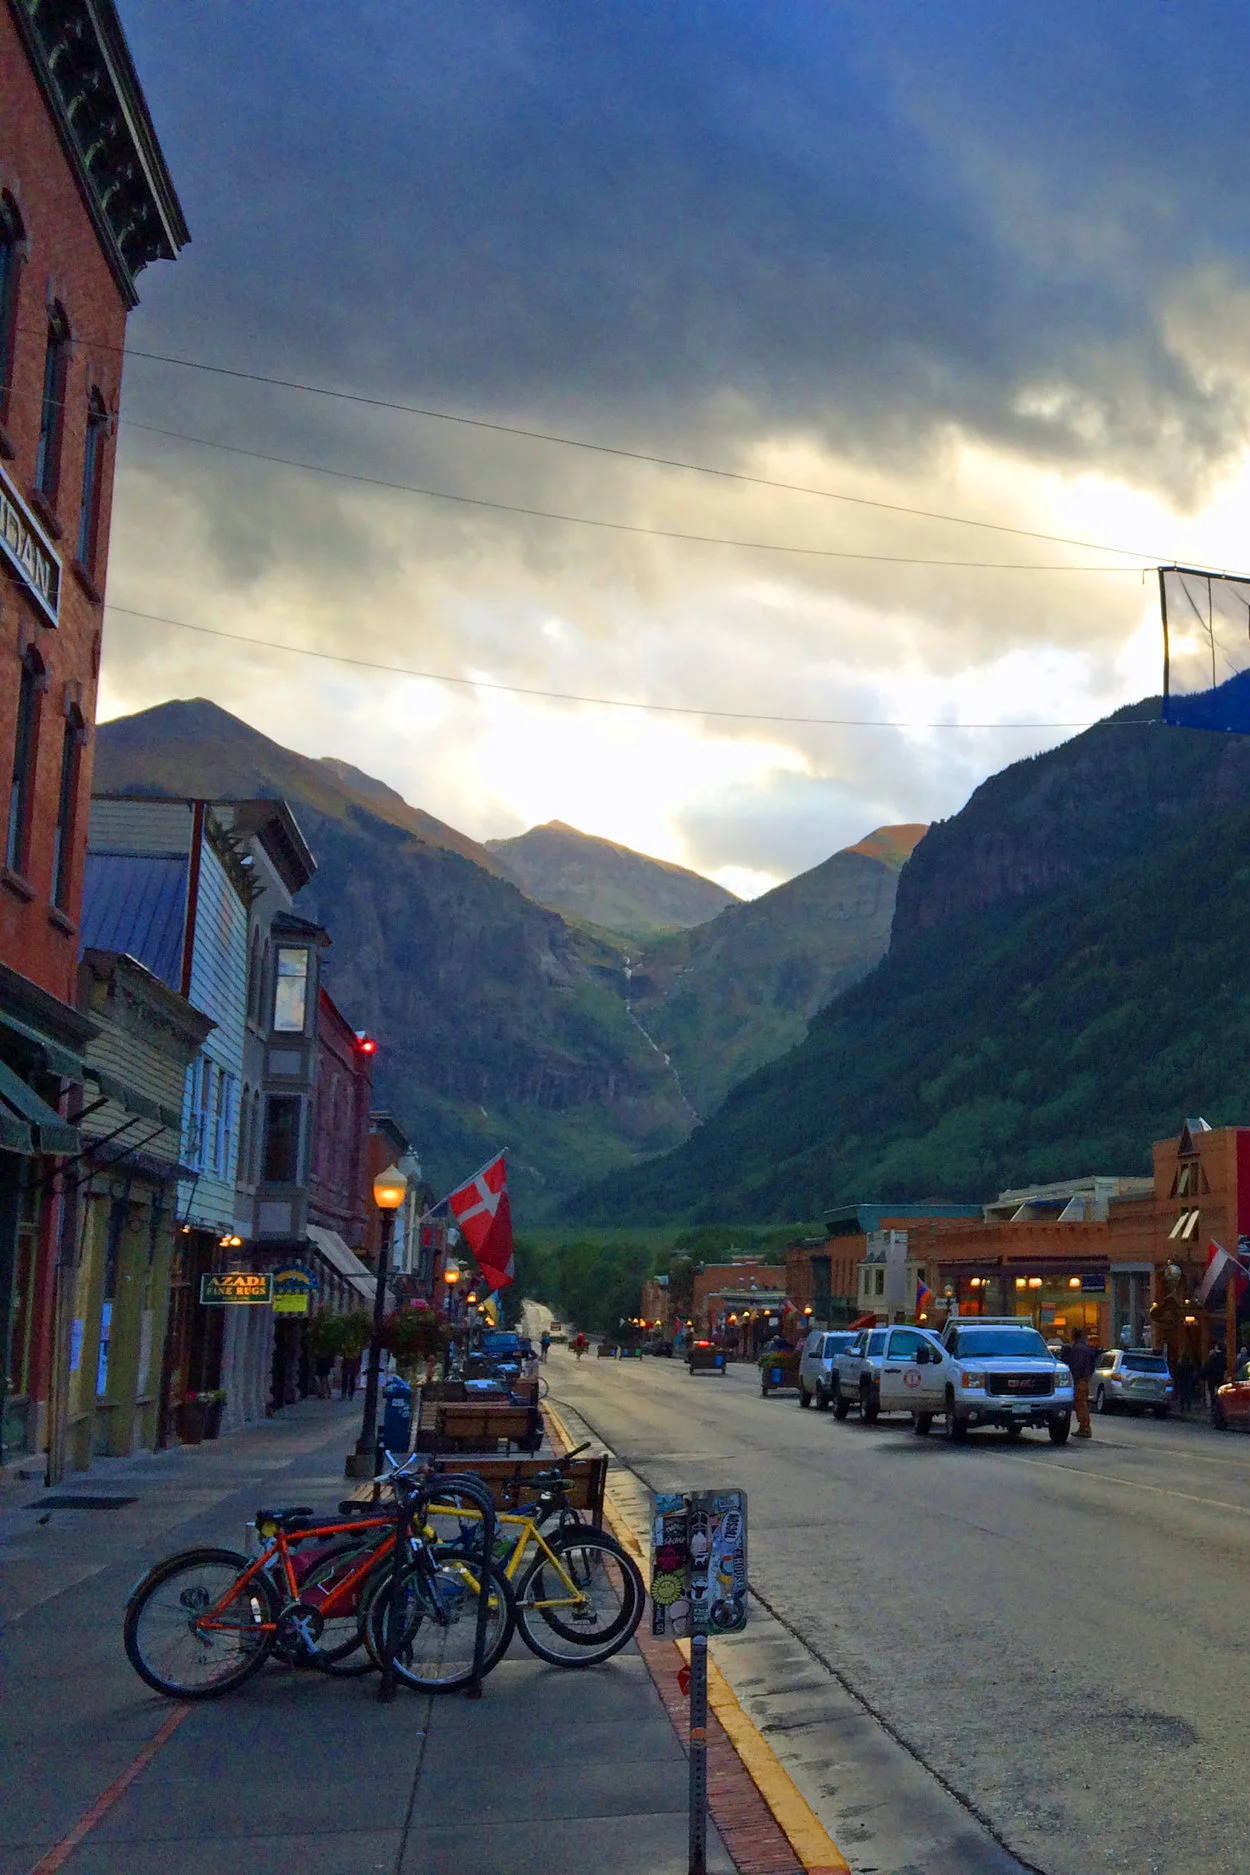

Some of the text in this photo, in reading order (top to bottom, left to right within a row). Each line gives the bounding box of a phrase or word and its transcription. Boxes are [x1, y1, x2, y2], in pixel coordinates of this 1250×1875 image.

[207, 1276, 267, 1286] AZADI
[206, 1287, 233, 1296] FINE
[236, 1287, 267, 1296] RUGS
